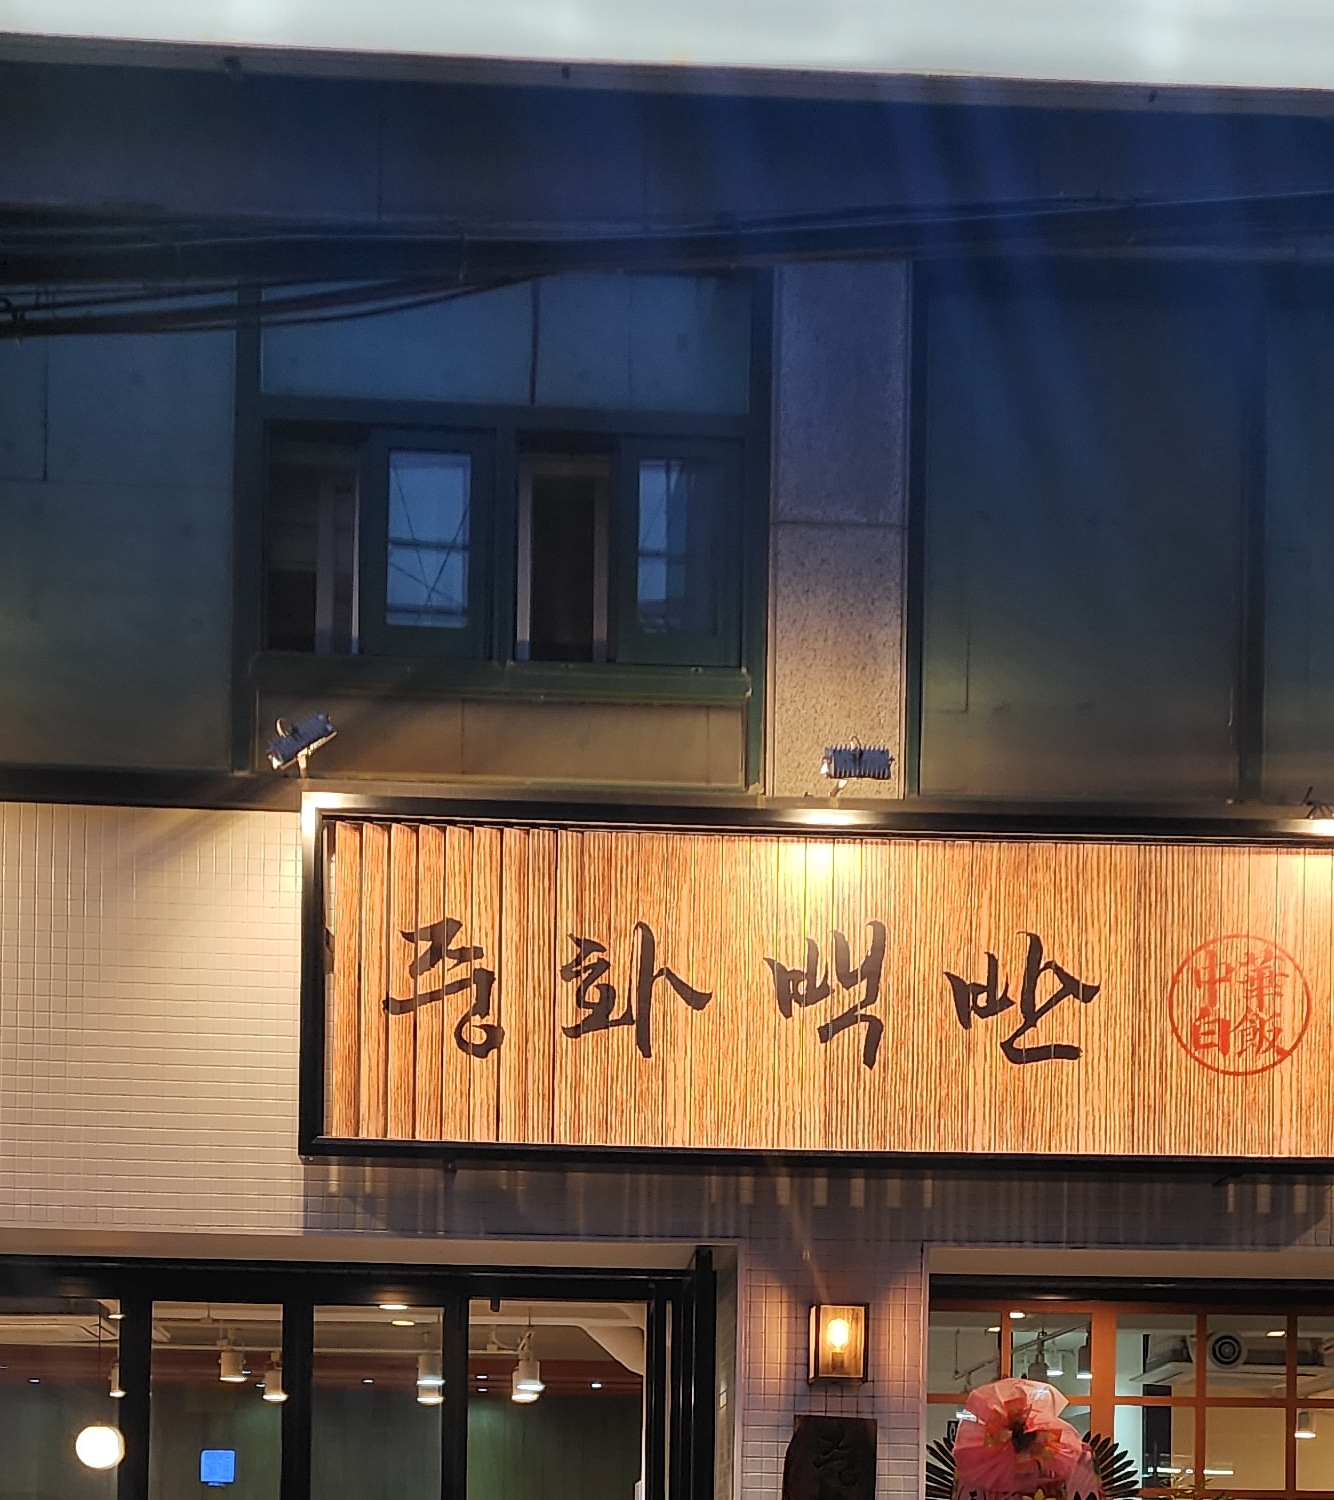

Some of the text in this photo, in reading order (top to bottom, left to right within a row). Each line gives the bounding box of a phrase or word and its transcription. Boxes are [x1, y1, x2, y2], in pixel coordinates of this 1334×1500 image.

[383, 918, 1101, 1070] 중화백반
[1192, 947, 1290, 1012] 中華
[1191, 1006, 1291, 1058] 白飯
